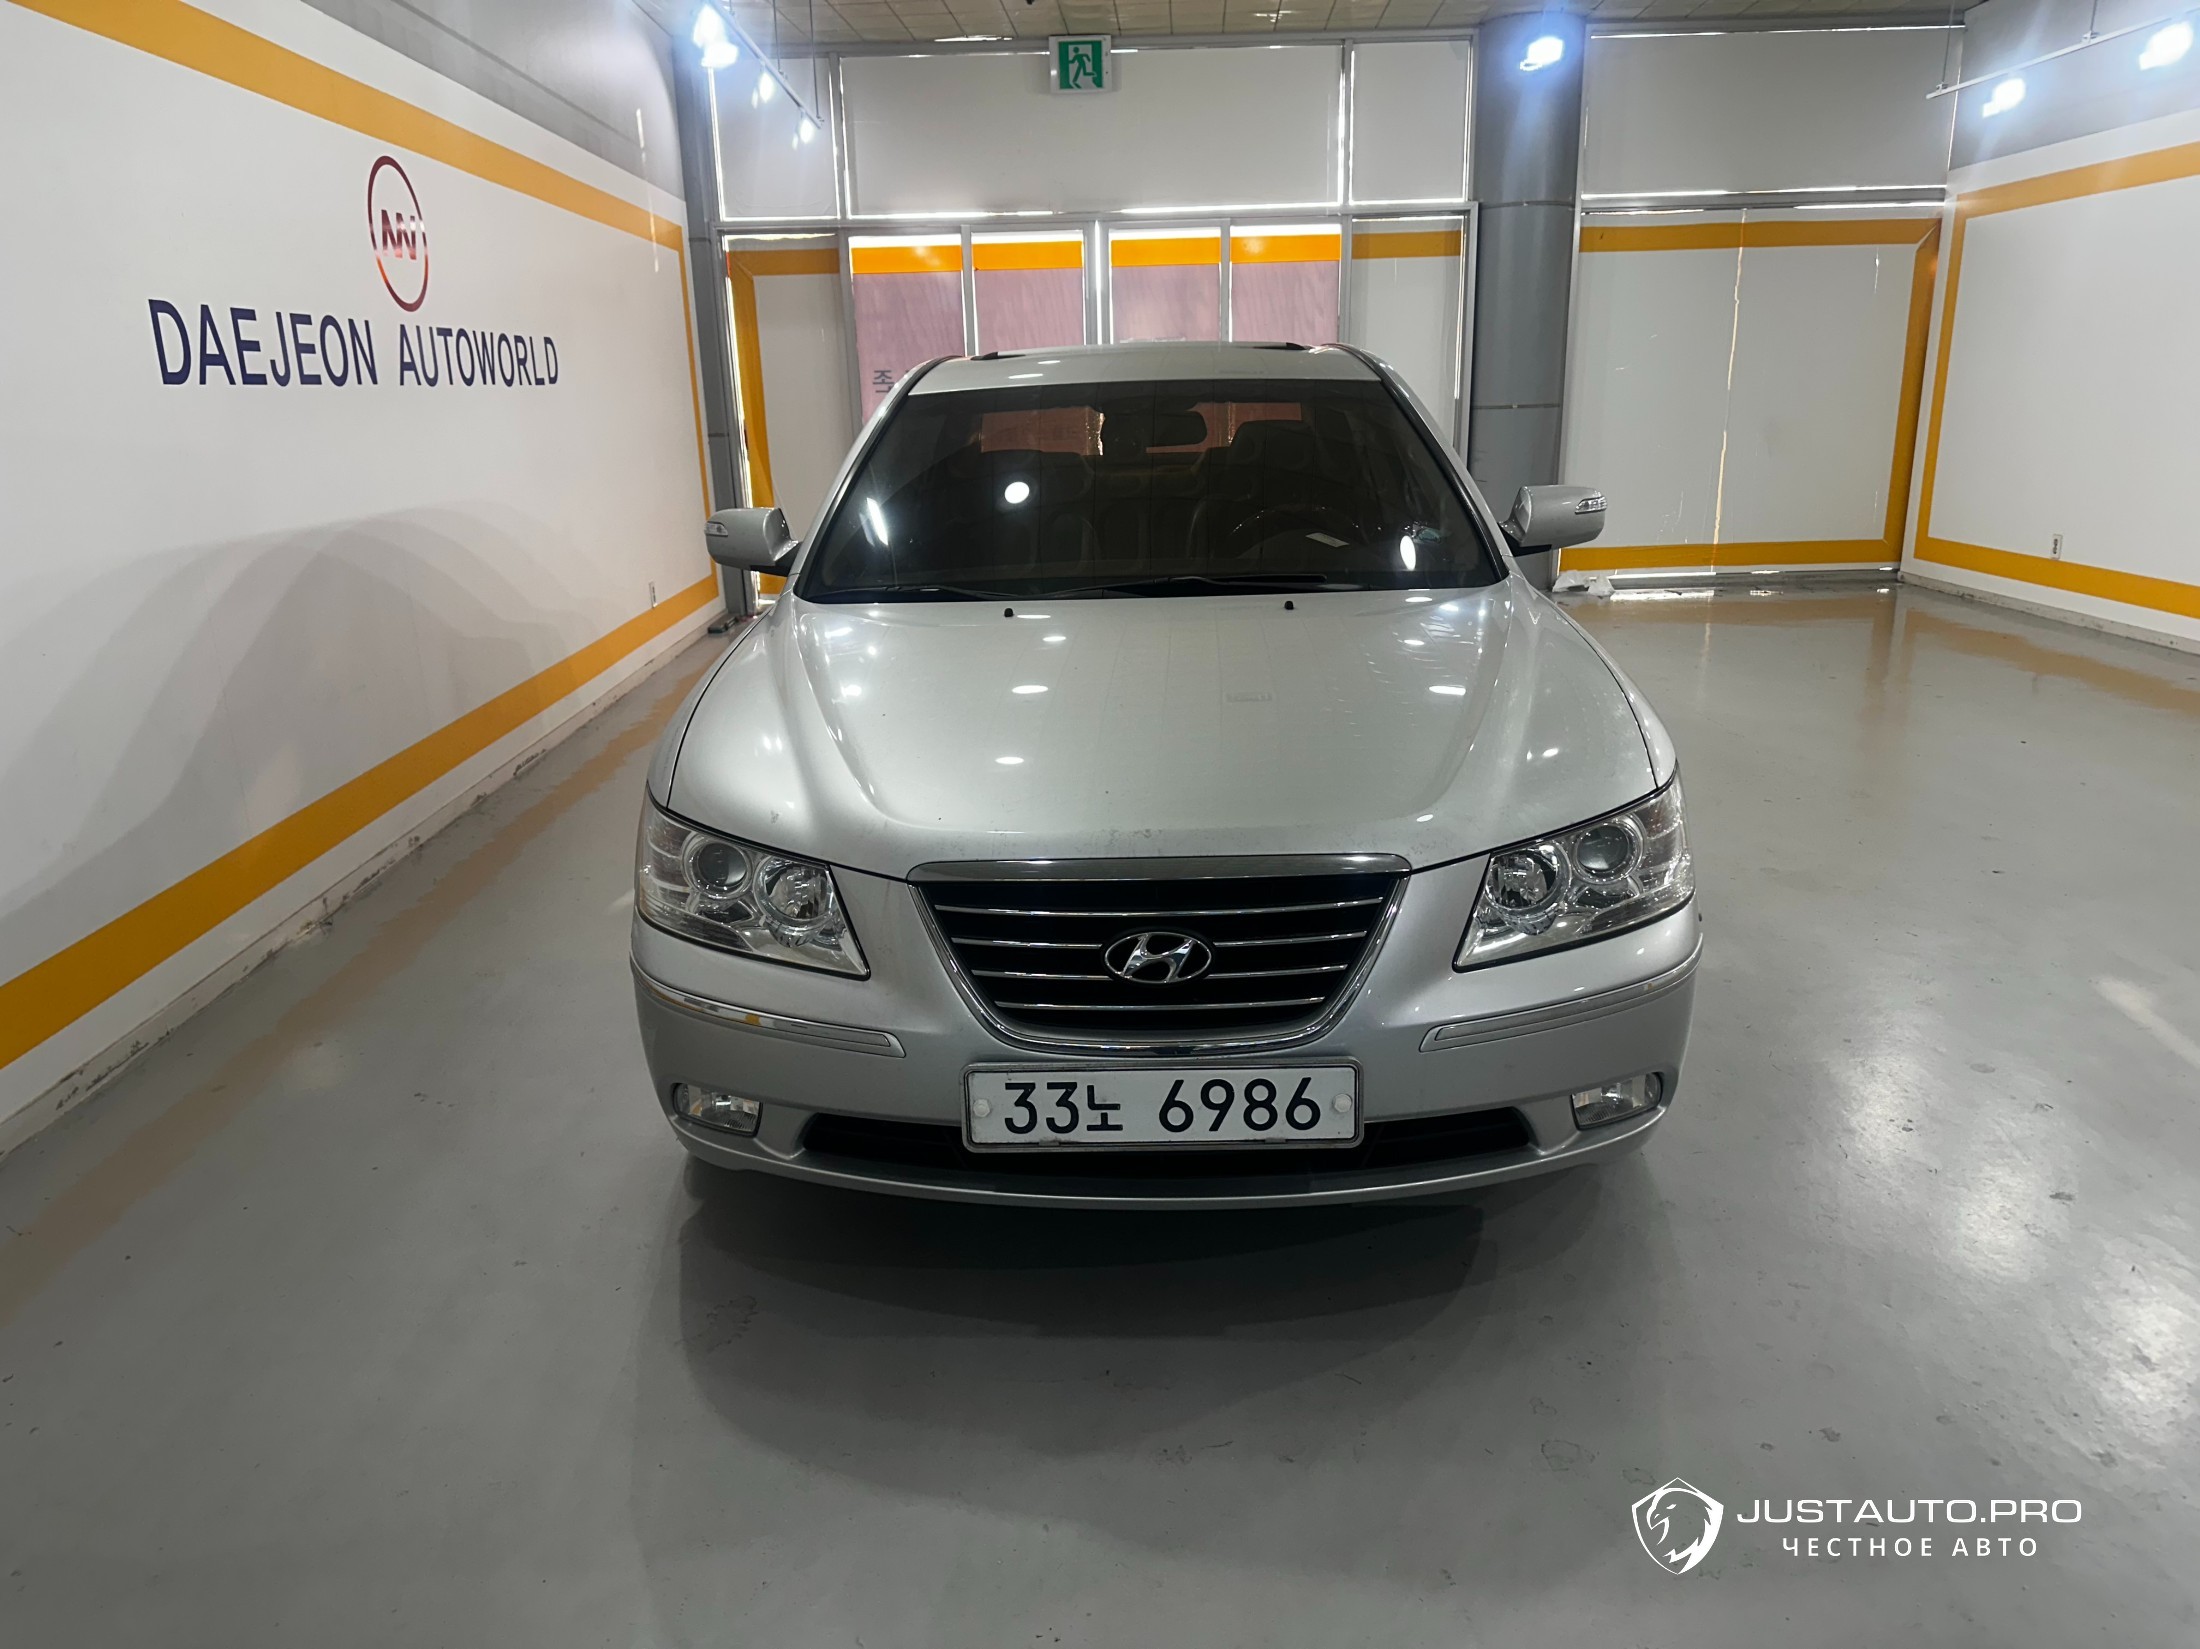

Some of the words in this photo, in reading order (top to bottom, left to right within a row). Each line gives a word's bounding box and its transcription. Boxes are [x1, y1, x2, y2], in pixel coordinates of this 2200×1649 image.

[148, 299, 379, 388] DAEJEON
[399, 323, 559, 388] AUTOWORLD
[1004, 1081, 1124, 1135] 33노
[1158, 1076, 1321, 1133] 6986
